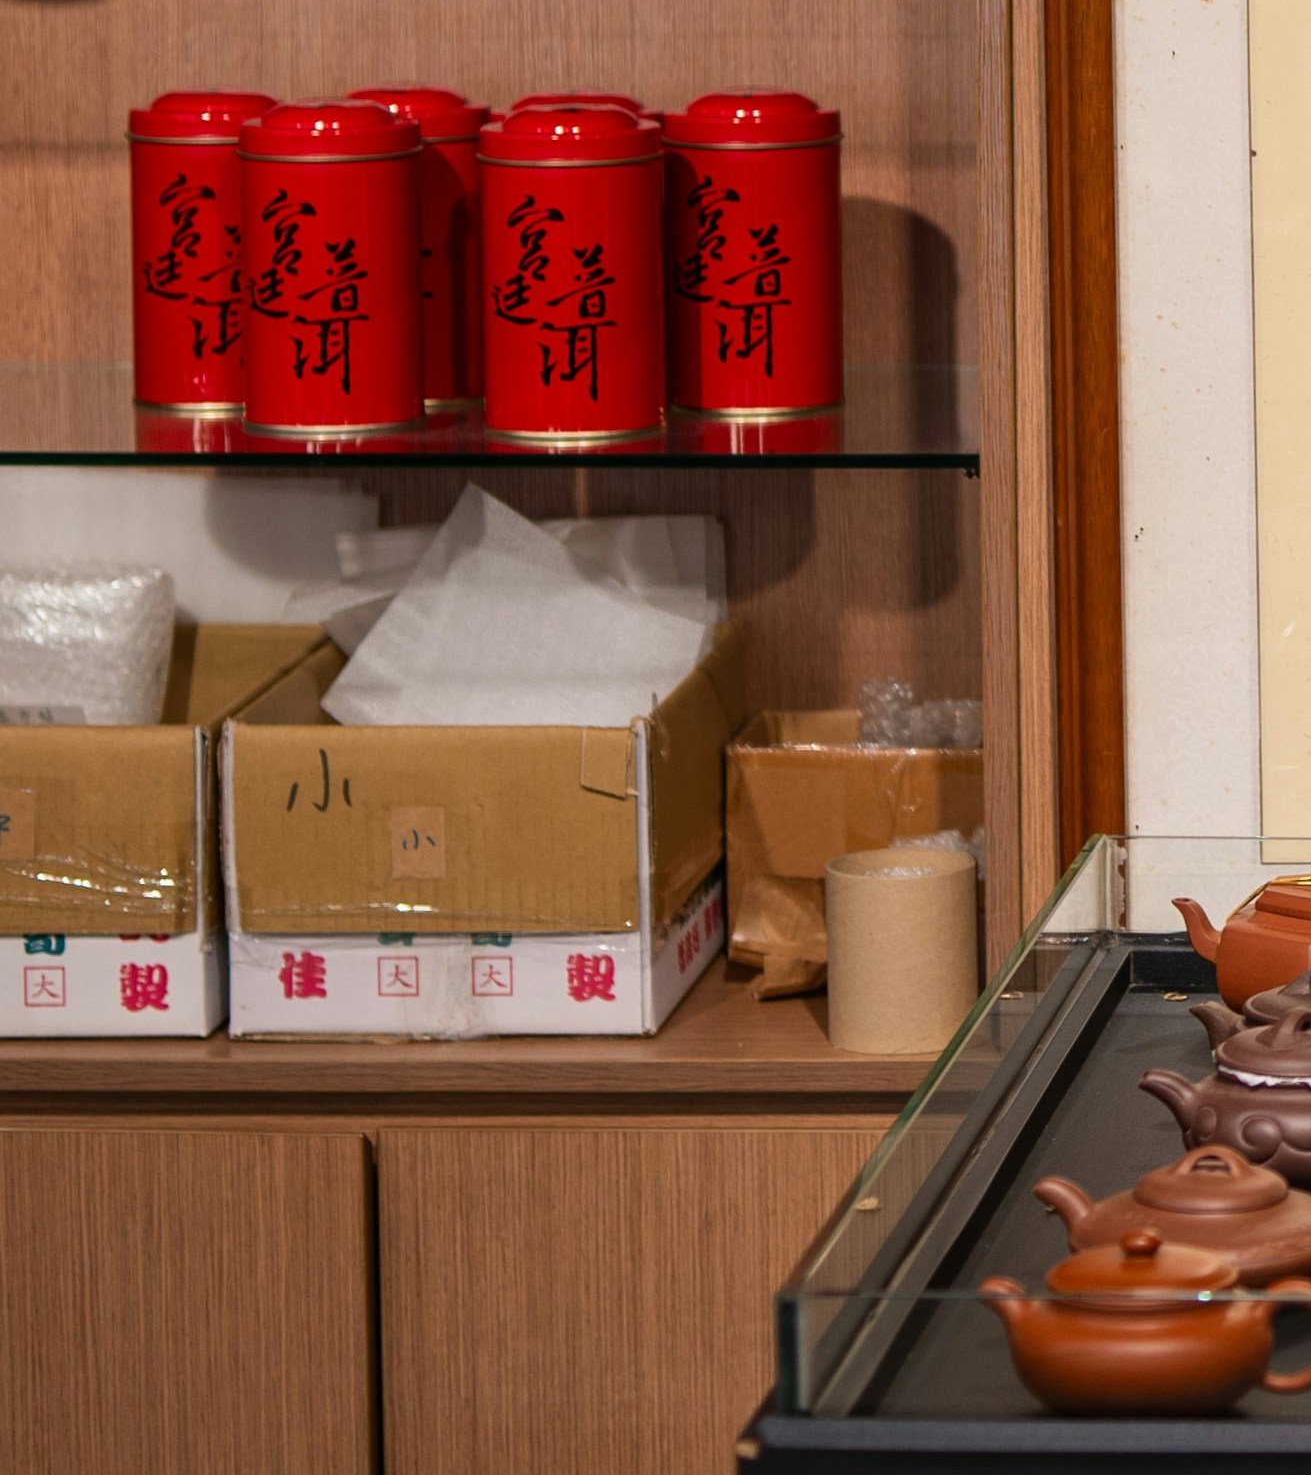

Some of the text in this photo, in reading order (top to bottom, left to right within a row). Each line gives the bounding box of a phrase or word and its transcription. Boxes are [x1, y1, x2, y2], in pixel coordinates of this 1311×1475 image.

[143, 172, 216, 299] 宮廷
[248, 188, 317, 319] 宮廷
[491, 194, 564, 325] 宮廷
[288, 237, 369, 396] 普洱
[535, 243, 617, 402] 普洱
[713, 223, 792, 380] 普洱
[286, 748, 352, 813] 小
[402, 828, 437, 851] 小
[119, 962, 170, 1012] 製
[278, 951, 328, 1000] 佳
[566, 953, 617, 1003] 製
